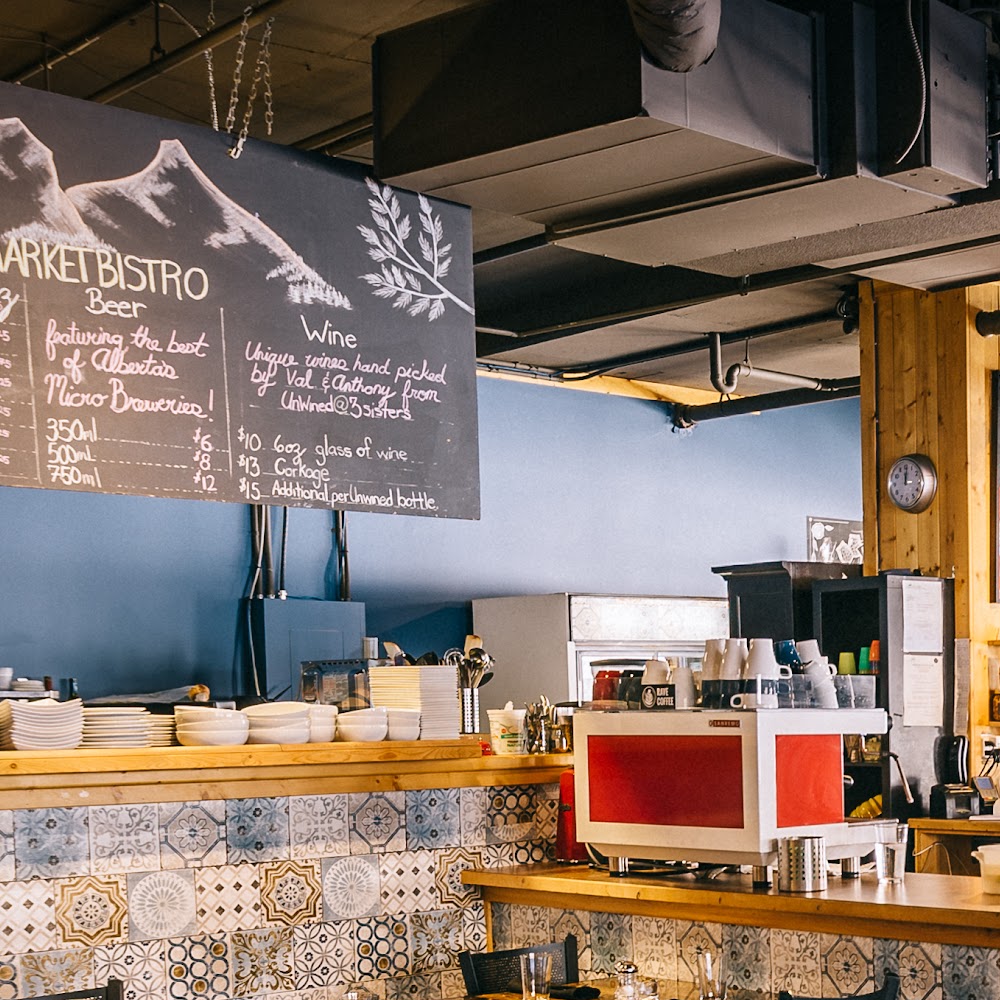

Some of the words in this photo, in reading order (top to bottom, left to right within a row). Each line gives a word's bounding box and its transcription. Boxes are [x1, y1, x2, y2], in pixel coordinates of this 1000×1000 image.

[0, 236, 96, 283] ARKET
[96, 248, 209, 300] BISTRO
[85, 287, 147, 318] Beer
[130, 325, 163, 352] the
[166, 330, 210, 358] best
[300, 314, 358, 349] Wine
[62, 349, 86, 384] of
[245, 341, 299, 377] Unique
[305, 353, 349, 371] wines
[353, 354, 391, 375] hand
[394, 359, 447, 385] picked
[44, 373, 109, 407] Micro
[251, 363, 276, 397] by
[286, 368, 314, 389] Val
[402, 380, 441, 409] from
[46, 417, 98, 442] 350ml
[192, 427, 213, 451] $6
[237, 425, 262, 451] $10
[315, 434, 352, 466] glass
[356, 437, 372, 459] of
[376, 447, 408, 461] wine
[193, 450, 211, 470] $8
[237, 454, 260, 477] $13
[274, 458, 330, 489] Corkage
[193, 470, 217, 491] $12
[239, 477, 261, 500] $15
[272, 479, 328, 502] Additional
[331, 492, 349, 508] per
[656, 696, 674, 706] COFFEE
